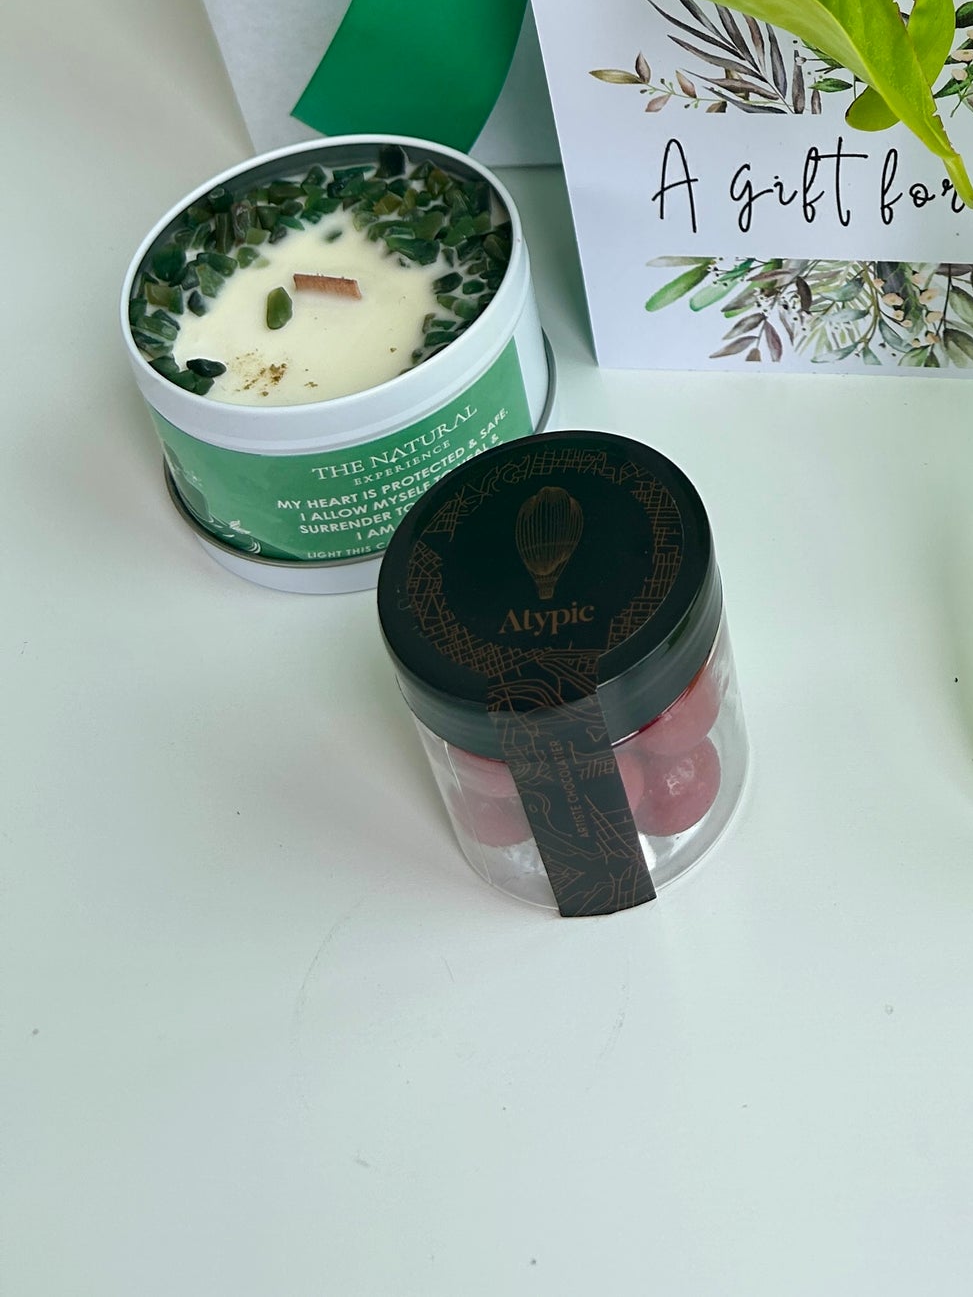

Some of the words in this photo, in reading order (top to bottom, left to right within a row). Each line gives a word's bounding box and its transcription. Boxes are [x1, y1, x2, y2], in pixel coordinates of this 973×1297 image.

[651, 138, 699, 233] A
[729, 136, 869, 233] gift
[880, 148, 966, 226] for
[277, 500, 301, 510] MY
[307, 493, 359, 509] HEART
[363, 488, 378, 500] IS
[381, 446, 465, 495] PROTECTED
[468, 438, 478, 449] &
[479, 407, 509, 440] SAFE.
[311, 459, 366, 480] THE
[369, 404, 478, 469] NATURAL
[353, 439, 451, 487] EXPERIENCE
[300, 513, 306, 522] I
[311, 504, 368, 522] ALLOW
[373, 481, 431, 511] MYSELF
[299, 510, 392, 535] SURRENDER
[356, 531, 362, 541] I
[367, 523, 396, 539] AM
[307, 550, 341, 559] LIGHT
[345, 545, 372, 556] THIS
[498, 601, 595, 637] Atypic
[549, 739, 580, 804] CHOCOLATIER
[569, 804, 590, 838] ARTISTE
